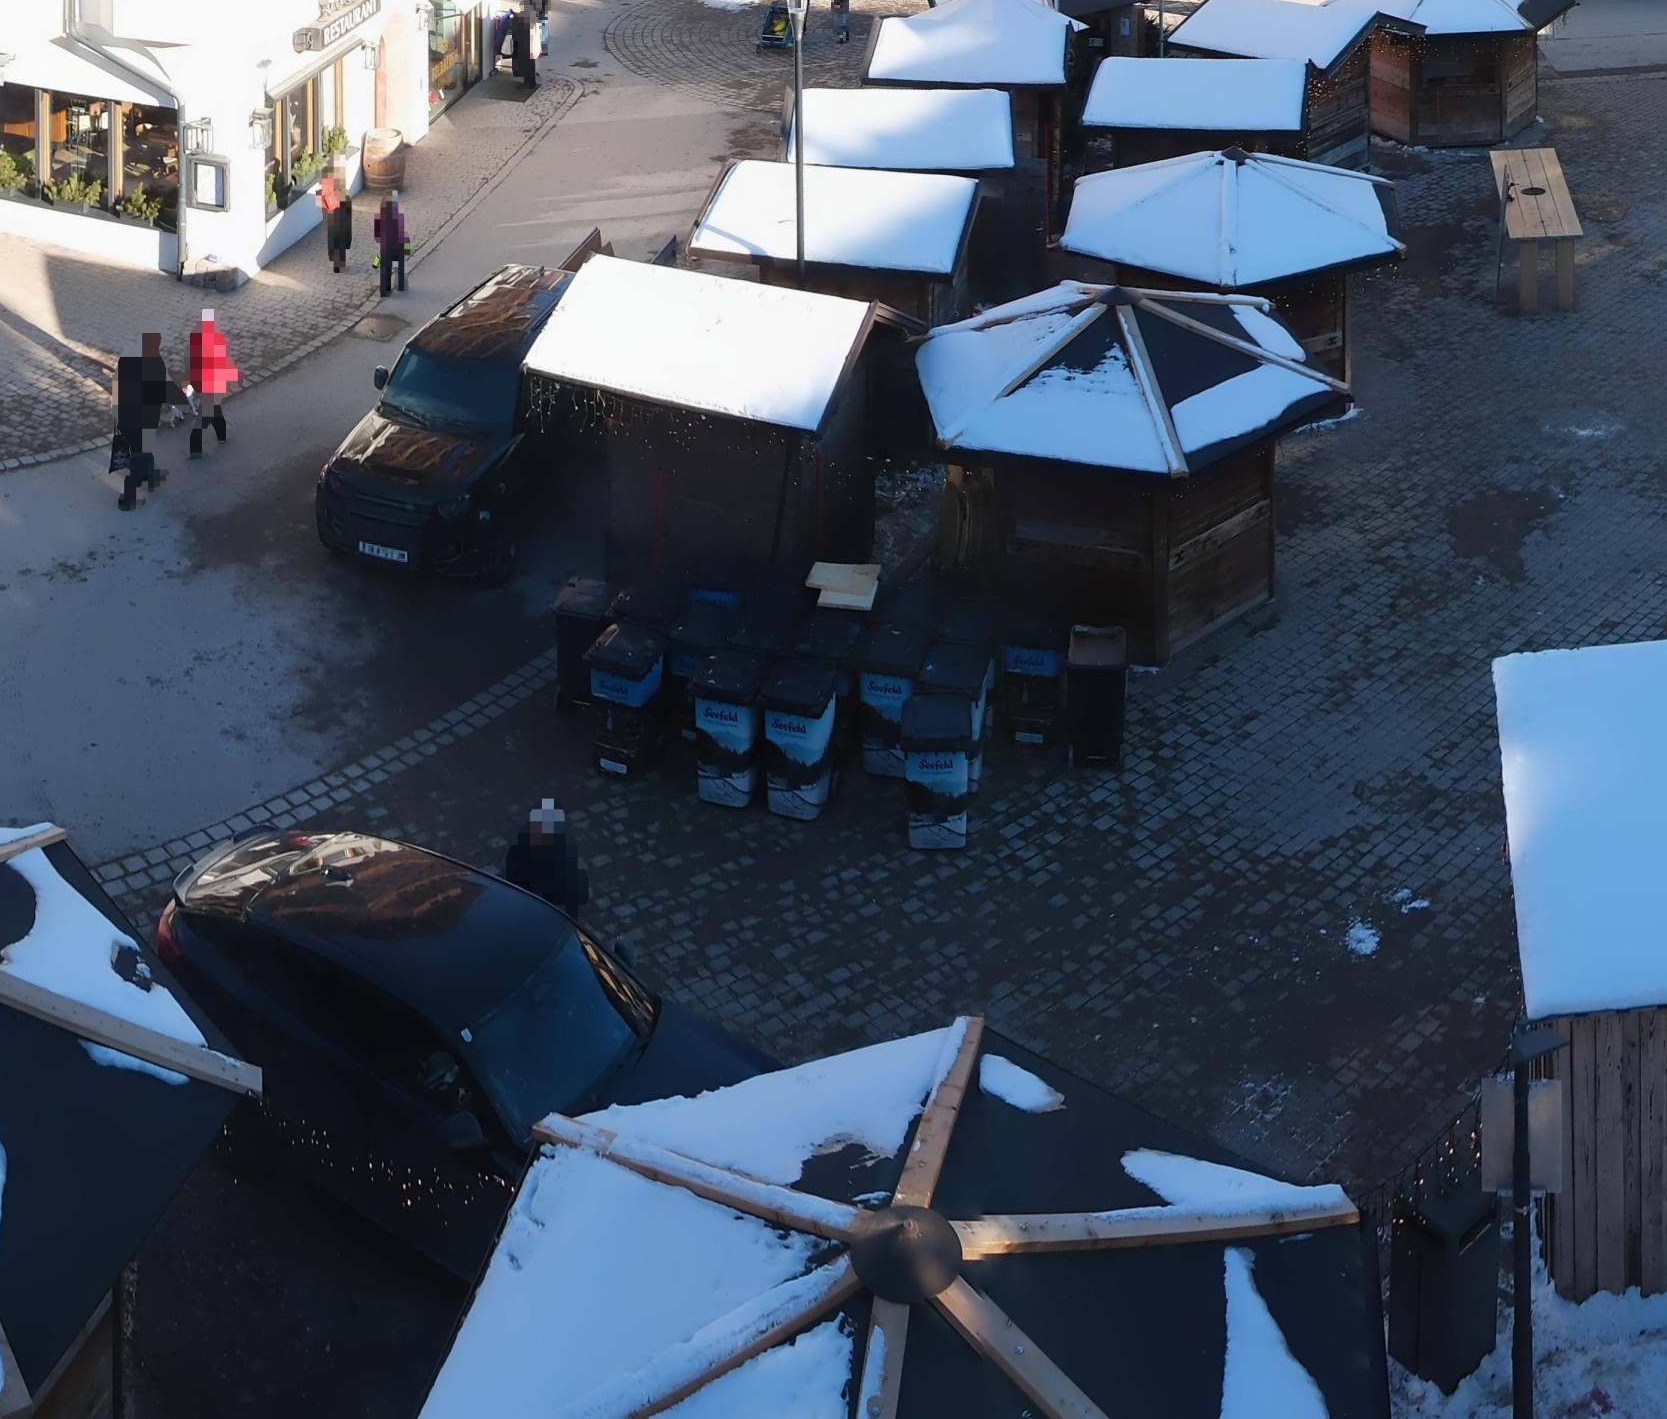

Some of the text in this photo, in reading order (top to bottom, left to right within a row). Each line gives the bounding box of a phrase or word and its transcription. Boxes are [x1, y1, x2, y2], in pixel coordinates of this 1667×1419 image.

[867, 681, 902, 695] Seefeld
[703, 707, 739, 723] Seefeld
[771, 718, 807, 734] Seefeld
[918, 758, 954, 770] Seefeld
